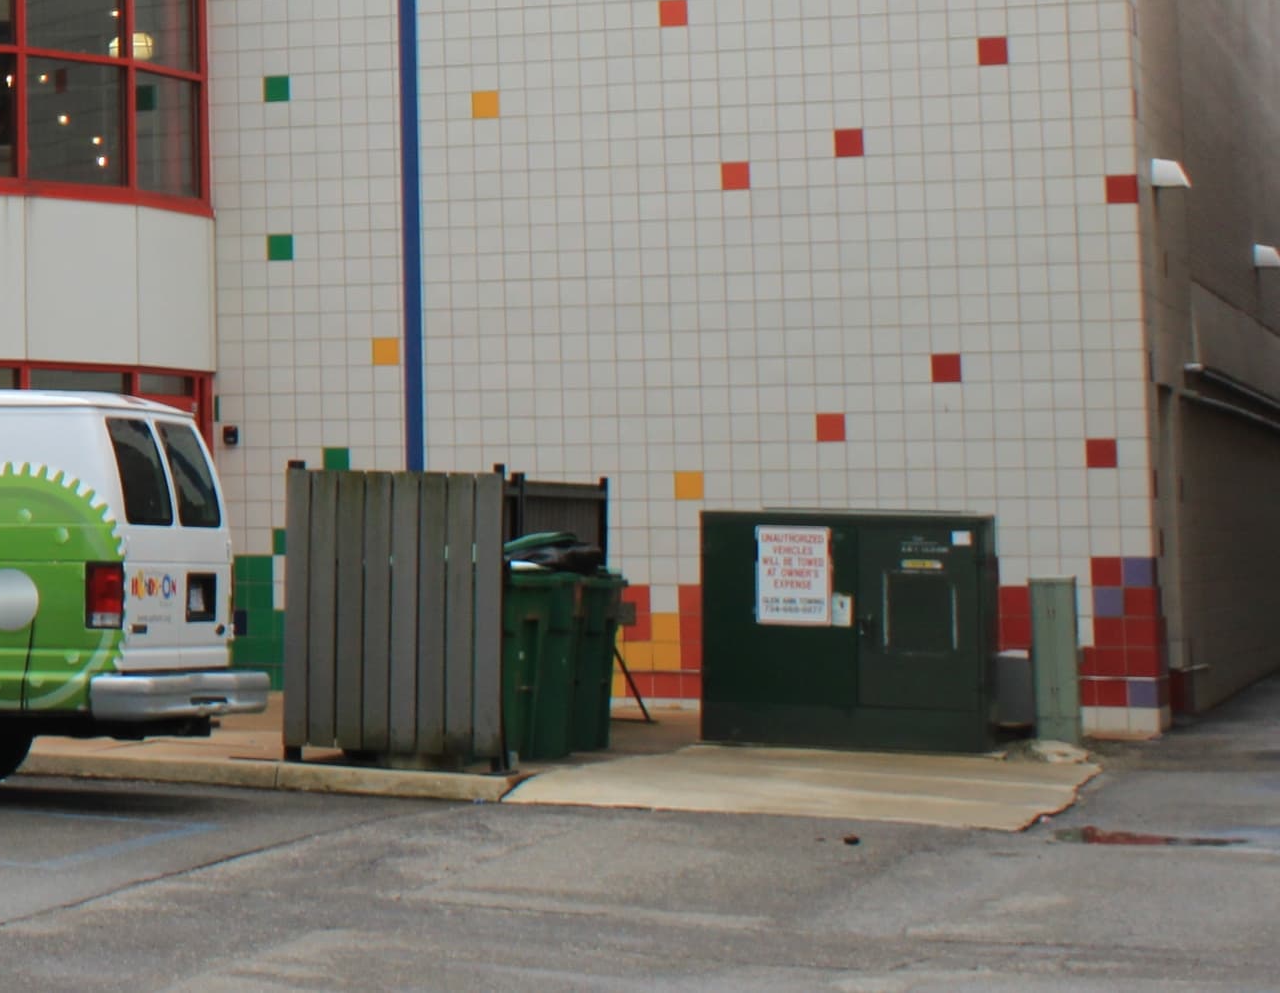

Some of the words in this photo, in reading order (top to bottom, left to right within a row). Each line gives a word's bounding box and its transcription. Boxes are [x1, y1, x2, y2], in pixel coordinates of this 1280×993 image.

[762, 533, 825, 544] UNAUTHORIZED
[773, 546, 813, 556] VEHICLES
[762, 557, 779, 566] WILL
[783, 557, 793, 566] BE
[798, 557, 825, 567] TOWED
[767, 567, 777, 577] AT
[781, 568, 819, 579] OWNER'S
[773, 579, 812, 590] EXPENSE
